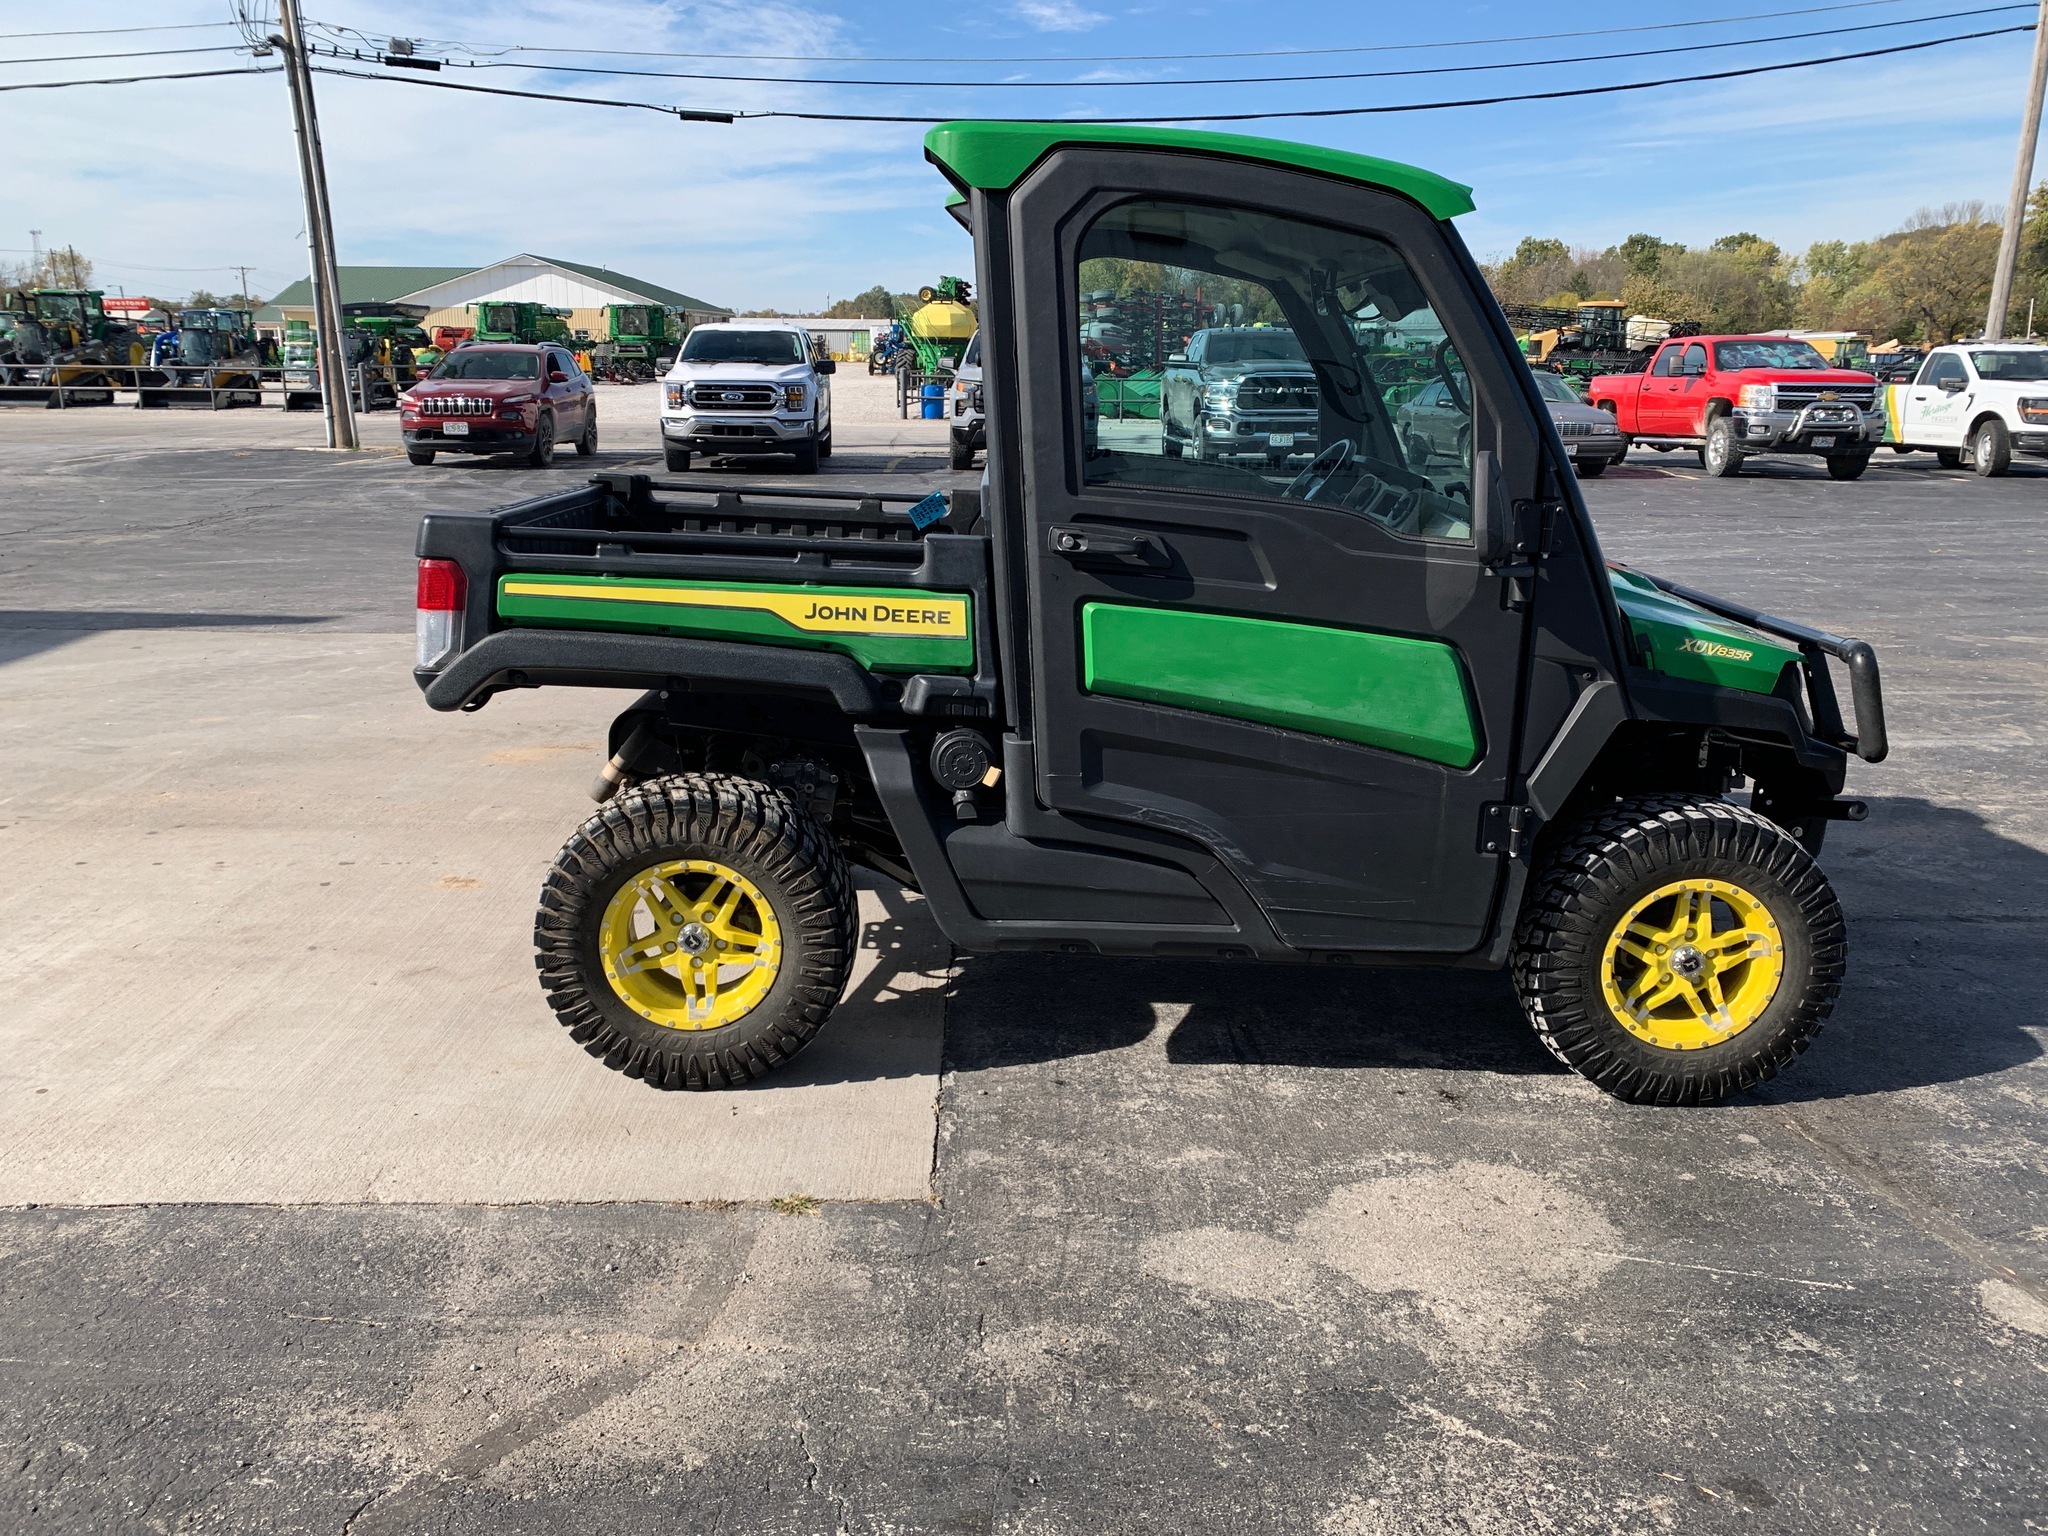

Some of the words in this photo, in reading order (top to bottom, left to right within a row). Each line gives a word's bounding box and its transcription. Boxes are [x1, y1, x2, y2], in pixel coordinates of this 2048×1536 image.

[102, 299, 146, 307] Firestone
[1920, 401, 1954, 420] Heritage
[804, 602, 867, 622] JOHN
[873, 605, 952, 625] DEERE
[1679, 638, 1754, 661] XUV835R
